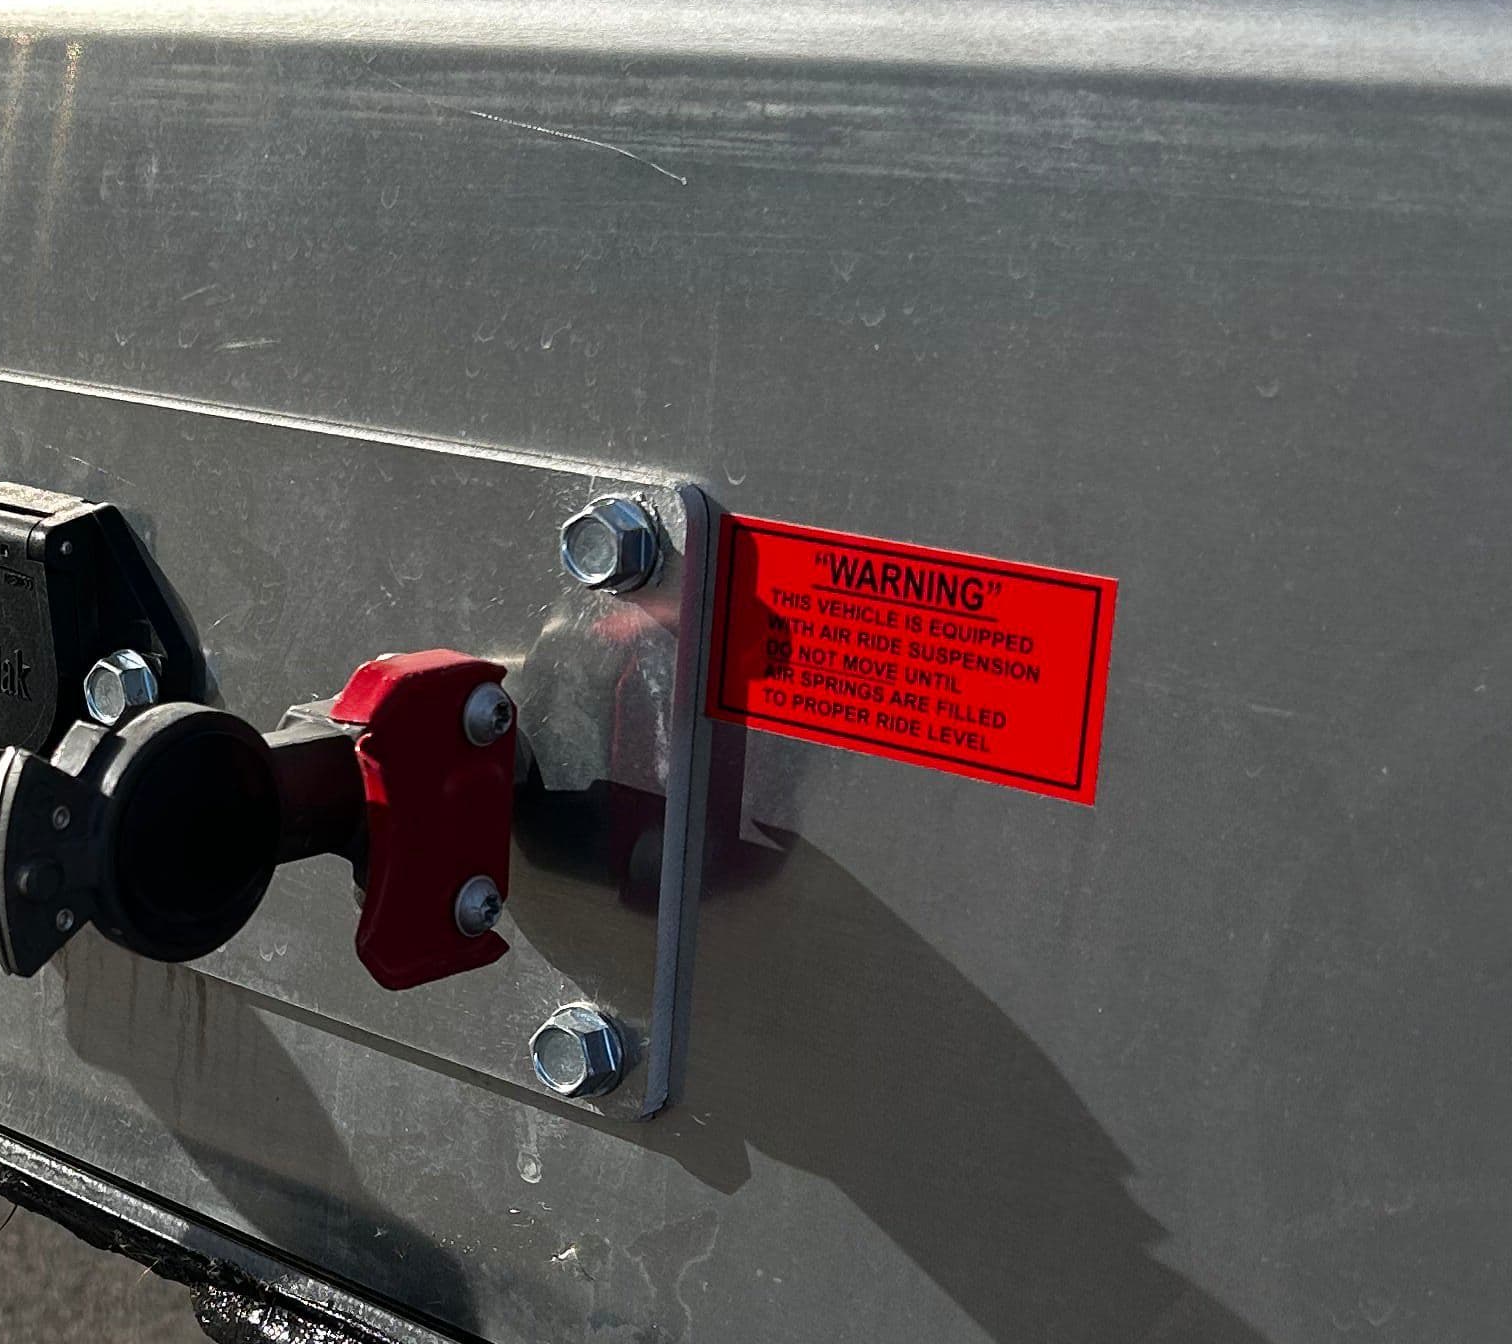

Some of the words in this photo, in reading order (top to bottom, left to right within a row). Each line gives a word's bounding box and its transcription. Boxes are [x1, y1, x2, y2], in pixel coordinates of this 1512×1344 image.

[767, 613, 814, 637] WITH
[820, 624, 850, 645] AIR
[857, 631, 901, 655] RIDE
[908, 642, 1041, 684] SUSPENSION
[770, 587, 811, 611] THIS
[818, 597, 899, 628] VEHICLE
[905, 615, 923, 633] IS
[929, 619, 1034, 655] EQUIPPED
[763, 663, 794, 684] AIR
[800, 670, 884, 704] SPRINGS
[889, 691, 929, 713] ARE
[937, 699, 1007, 730] FILLED
[766, 639, 792, 659] DO
[798, 644, 838, 666] NOT
[843, 655, 897, 681] MOVE
[905, 668, 962, 694] UNTIL
[763, 687, 787, 707] TO
[792, 694, 870, 724] PROPER
[876, 713, 921, 737] RIDE
[927, 725, 991, 753] LEVEL
